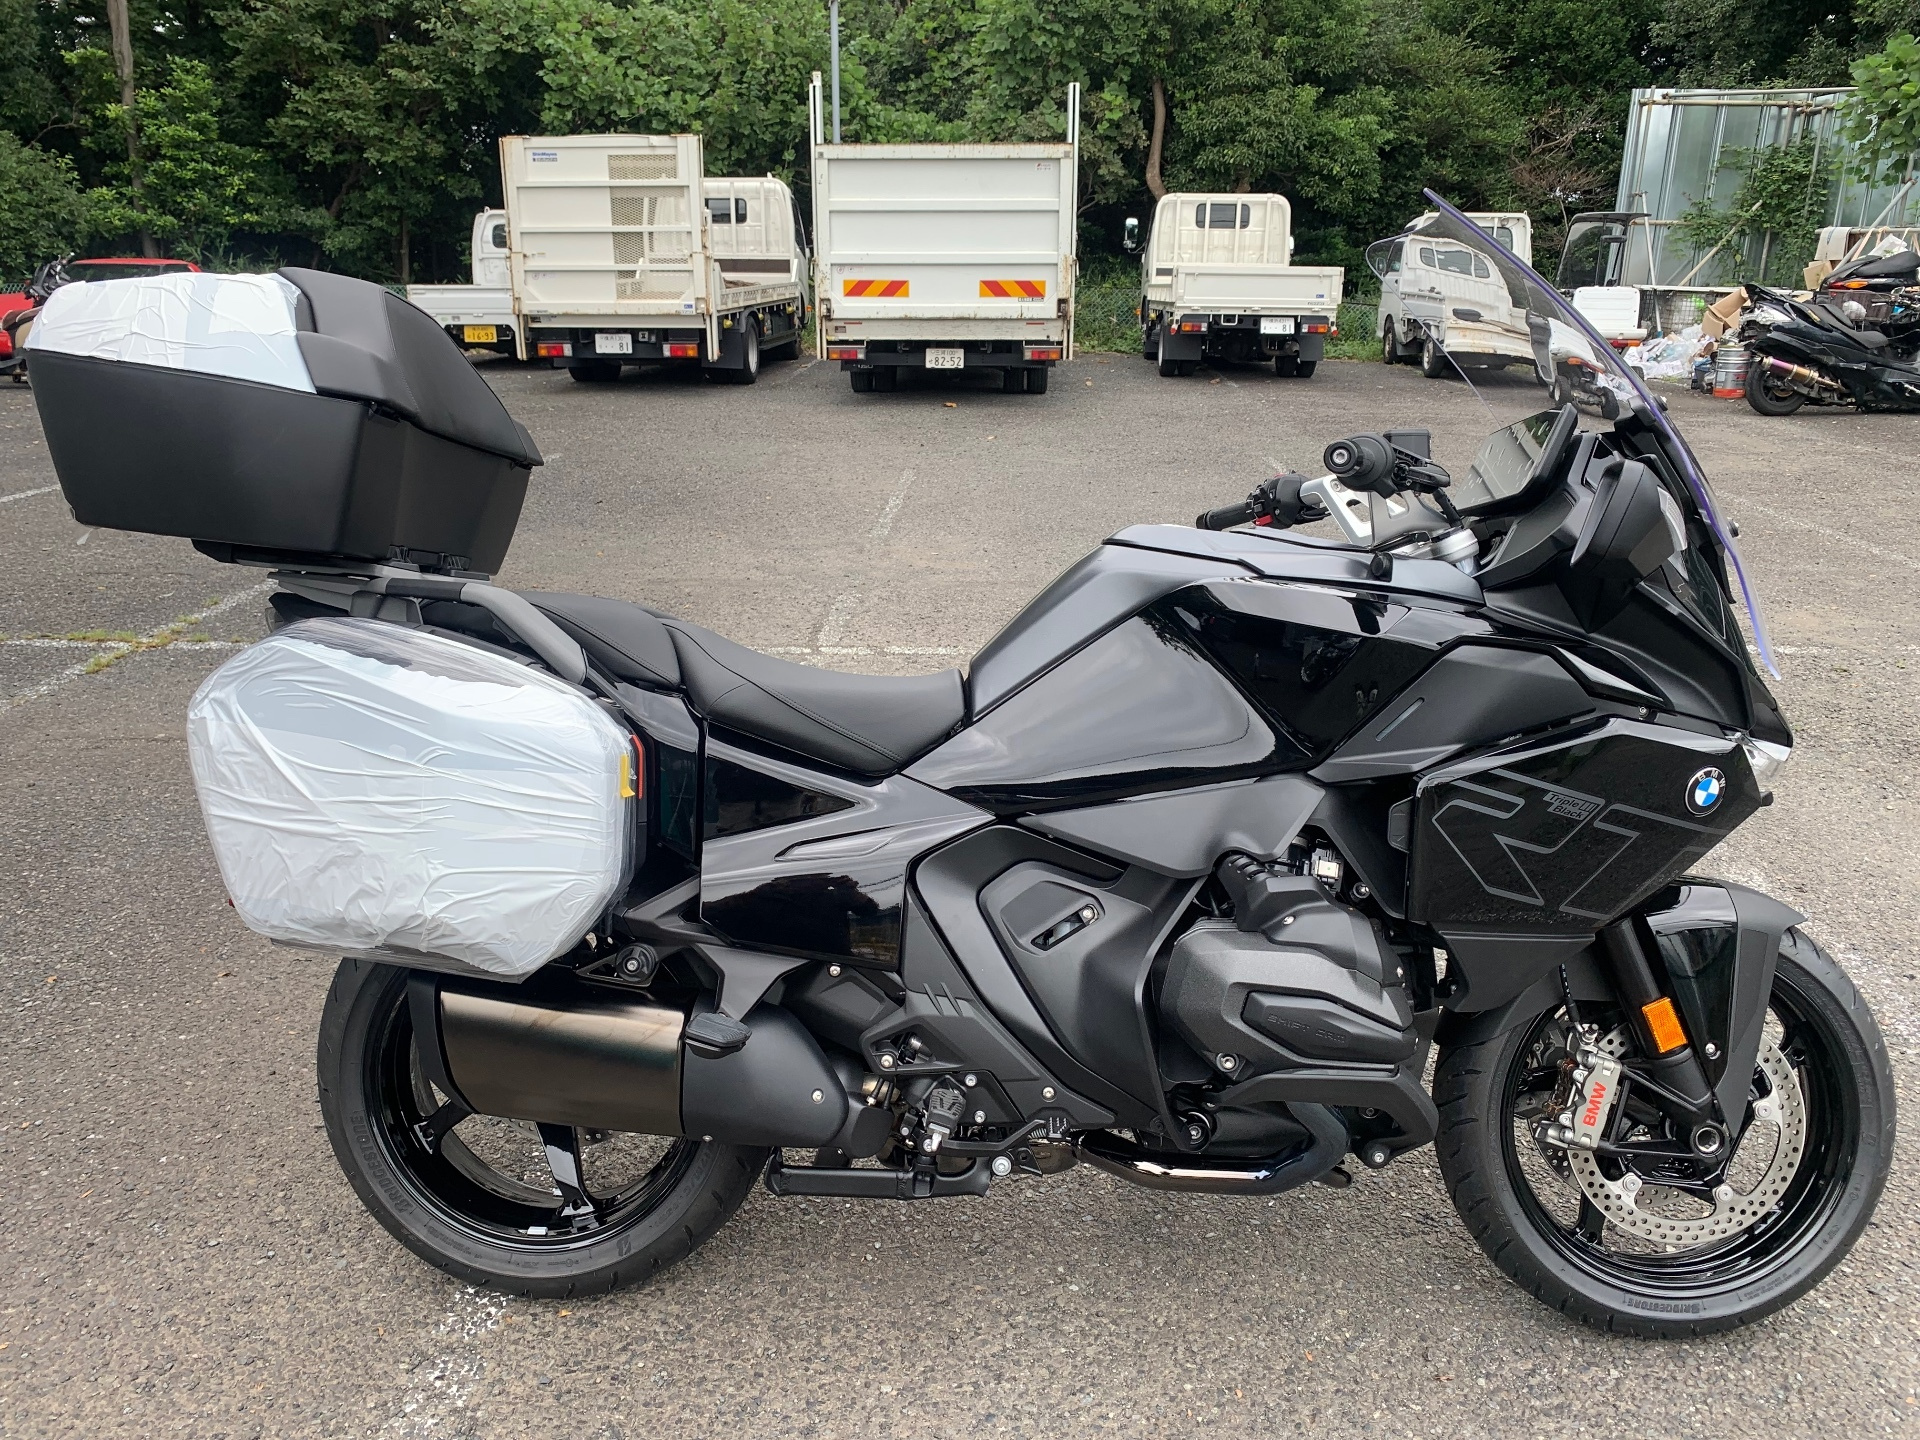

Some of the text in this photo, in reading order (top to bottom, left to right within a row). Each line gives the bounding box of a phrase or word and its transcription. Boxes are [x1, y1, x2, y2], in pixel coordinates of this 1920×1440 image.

[1282, 324, 1291, 333] 81
[619, 342, 629, 351] 81
[934, 356, 962, 367] 82-52
[1698, 769, 1726, 788] BMW
[1549, 793, 1580, 808] Triple
[1553, 805, 1585, 819] Black
[1582, 1081, 1607, 1127] BMW
